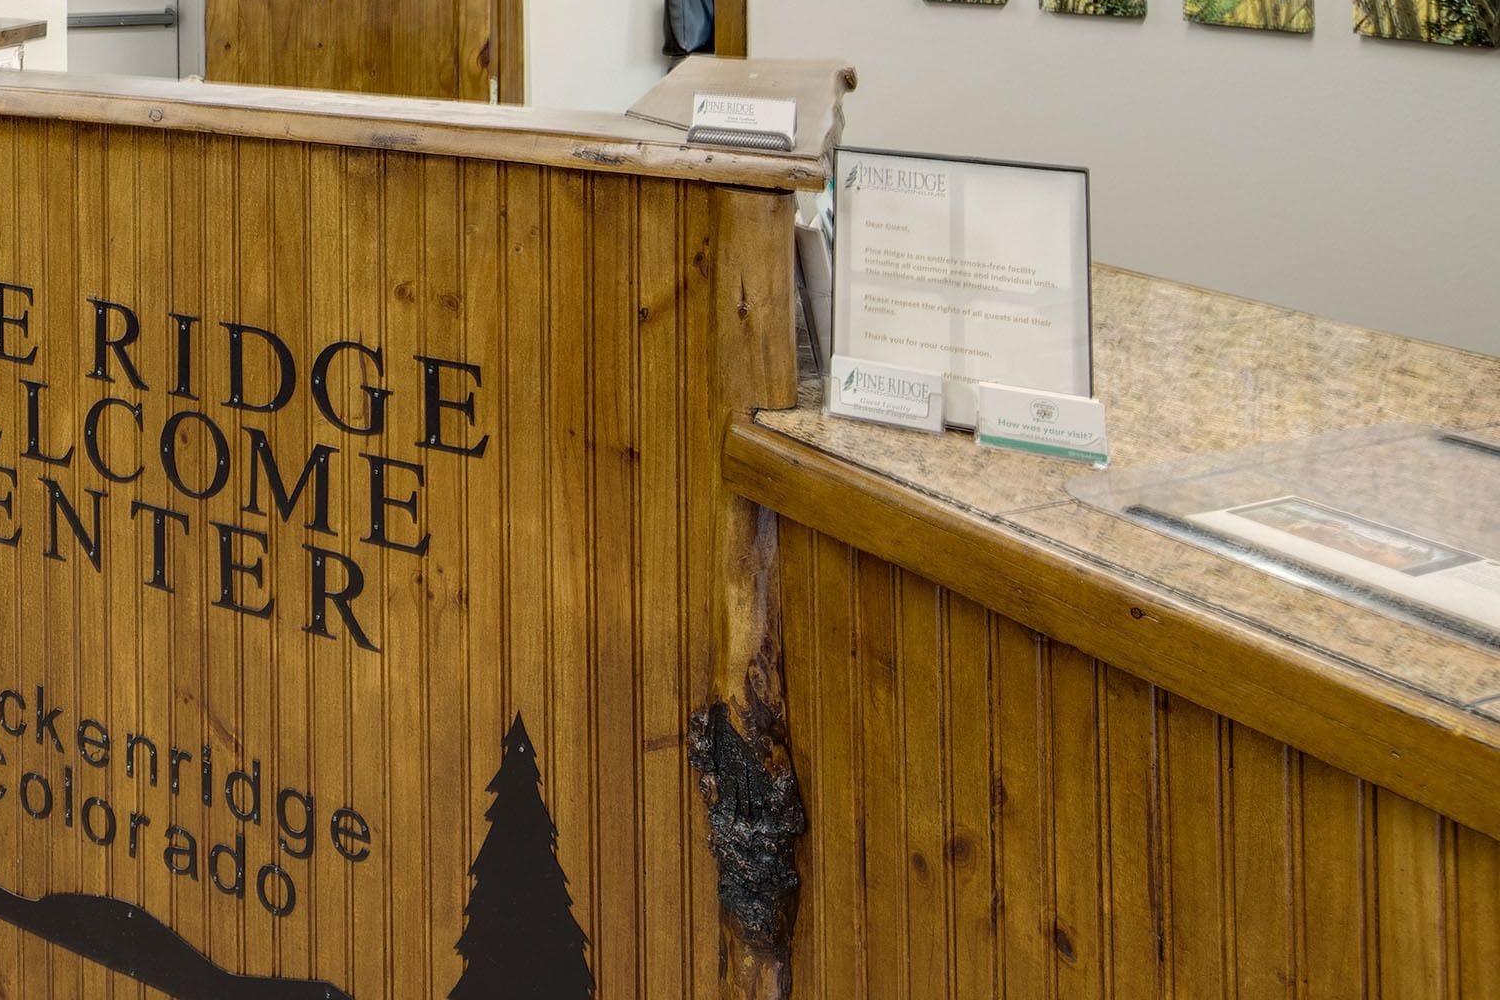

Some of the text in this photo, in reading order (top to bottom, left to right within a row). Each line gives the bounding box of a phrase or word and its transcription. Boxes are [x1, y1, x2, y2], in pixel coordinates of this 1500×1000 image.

[706, 100, 725, 112] PINE
[727, 102, 755, 114] RIDGE
[859, 165, 894, 186] PINE
[898, 170, 946, 193] RIDGE
[86, 295, 490, 460] RIDGE
[856, 370, 885, 391] PINE
[888, 378, 929, 399] RIDGE
[997, 418, 1021, 430] How
[1022, 423, 1041, 433] was
[1043, 428, 1066, 439] your
[1067, 429, 1093, 441] visit?
